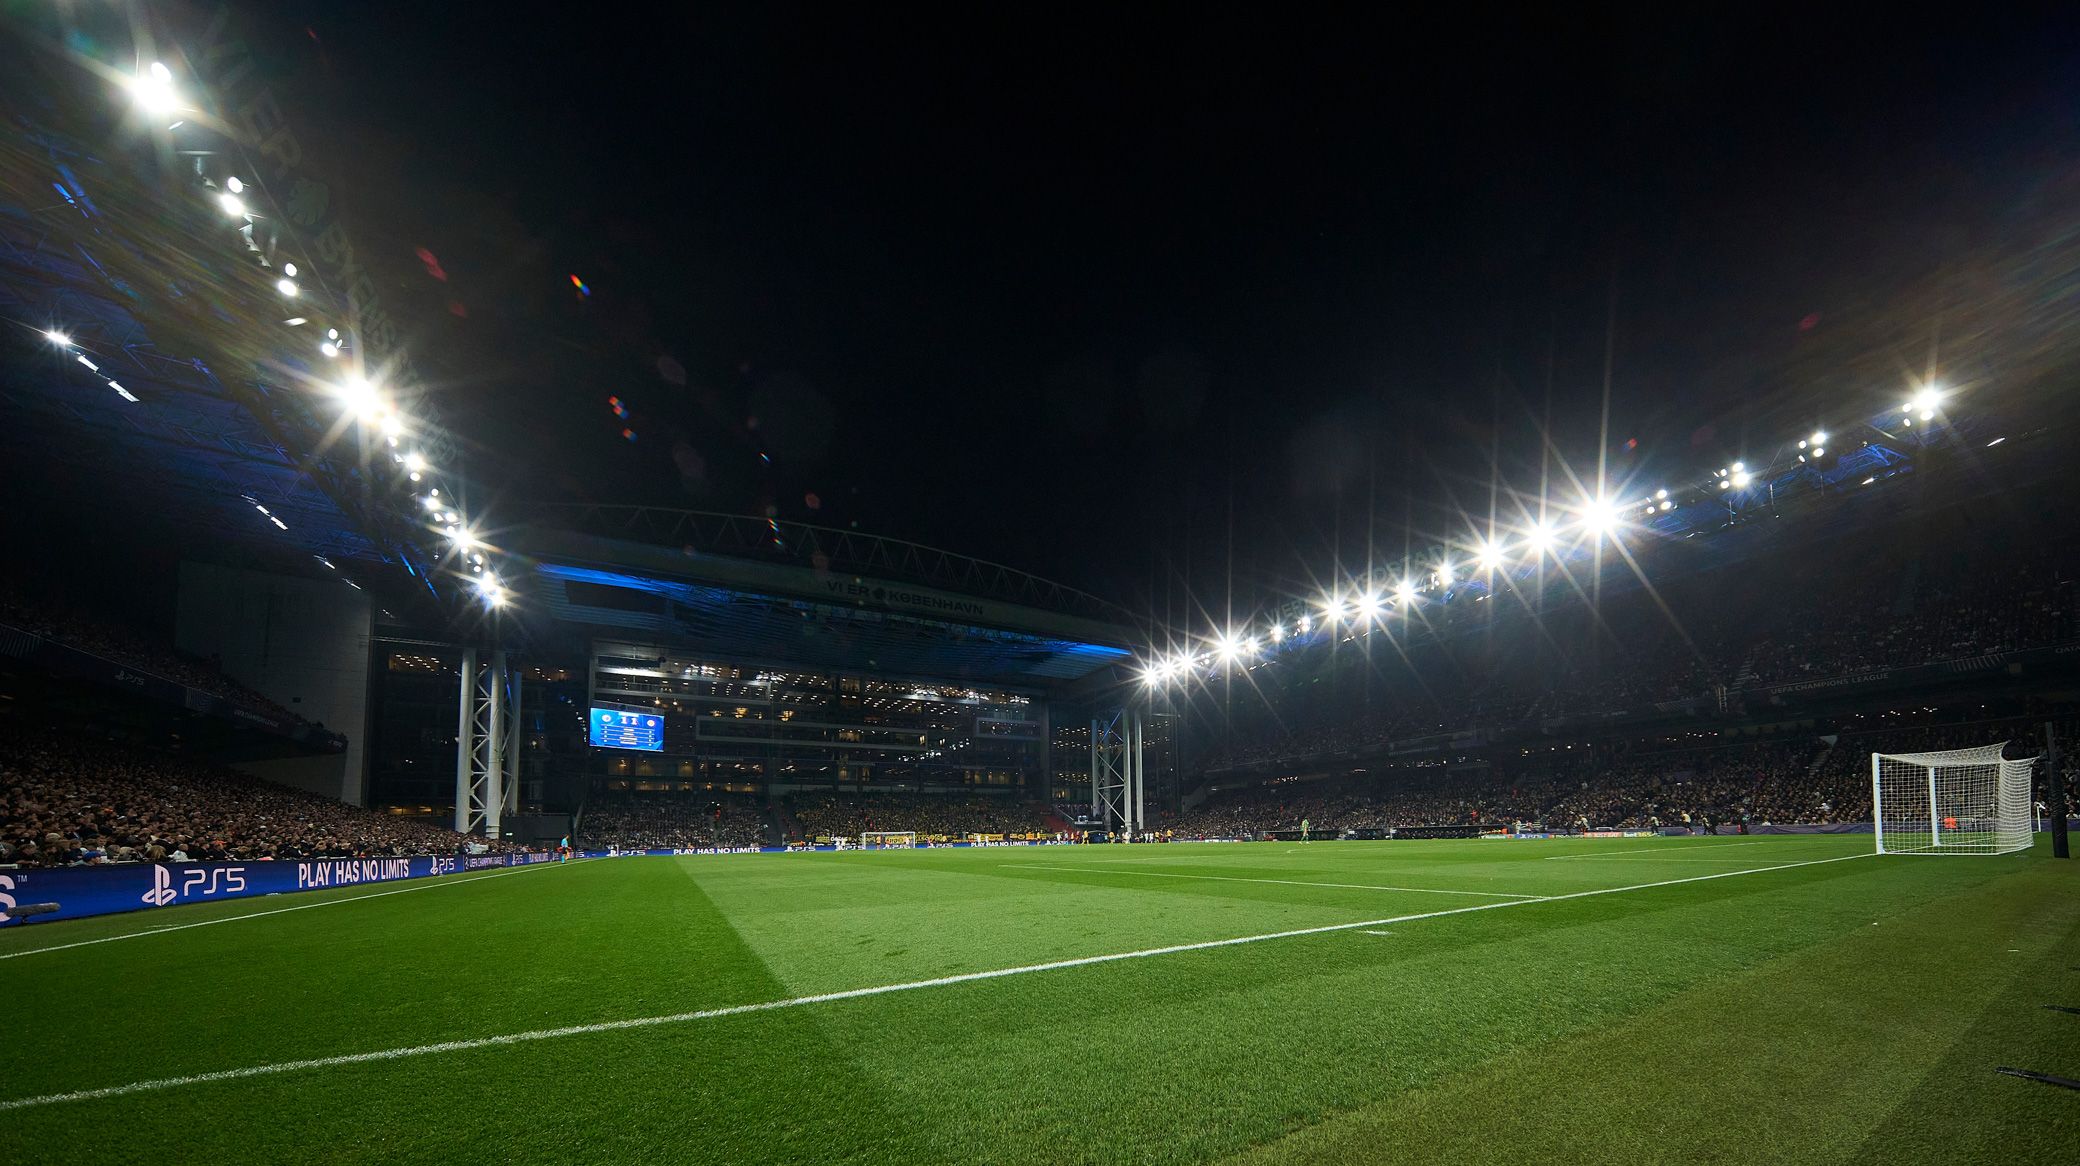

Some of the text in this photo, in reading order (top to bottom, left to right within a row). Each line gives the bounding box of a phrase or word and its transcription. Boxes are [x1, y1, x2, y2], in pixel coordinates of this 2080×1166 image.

[827, 580, 984, 615] VI ER KØBENHAVN
[1771, 672, 1889, 695] UEFA CHAMPIONS LEAGUE
[439, 858, 455, 873] PS5
[620, 849, 646, 857] PS5
[183, 867, 246, 897] PS5
[298, 858, 409, 888] PLAY HAS NO LIMITS
